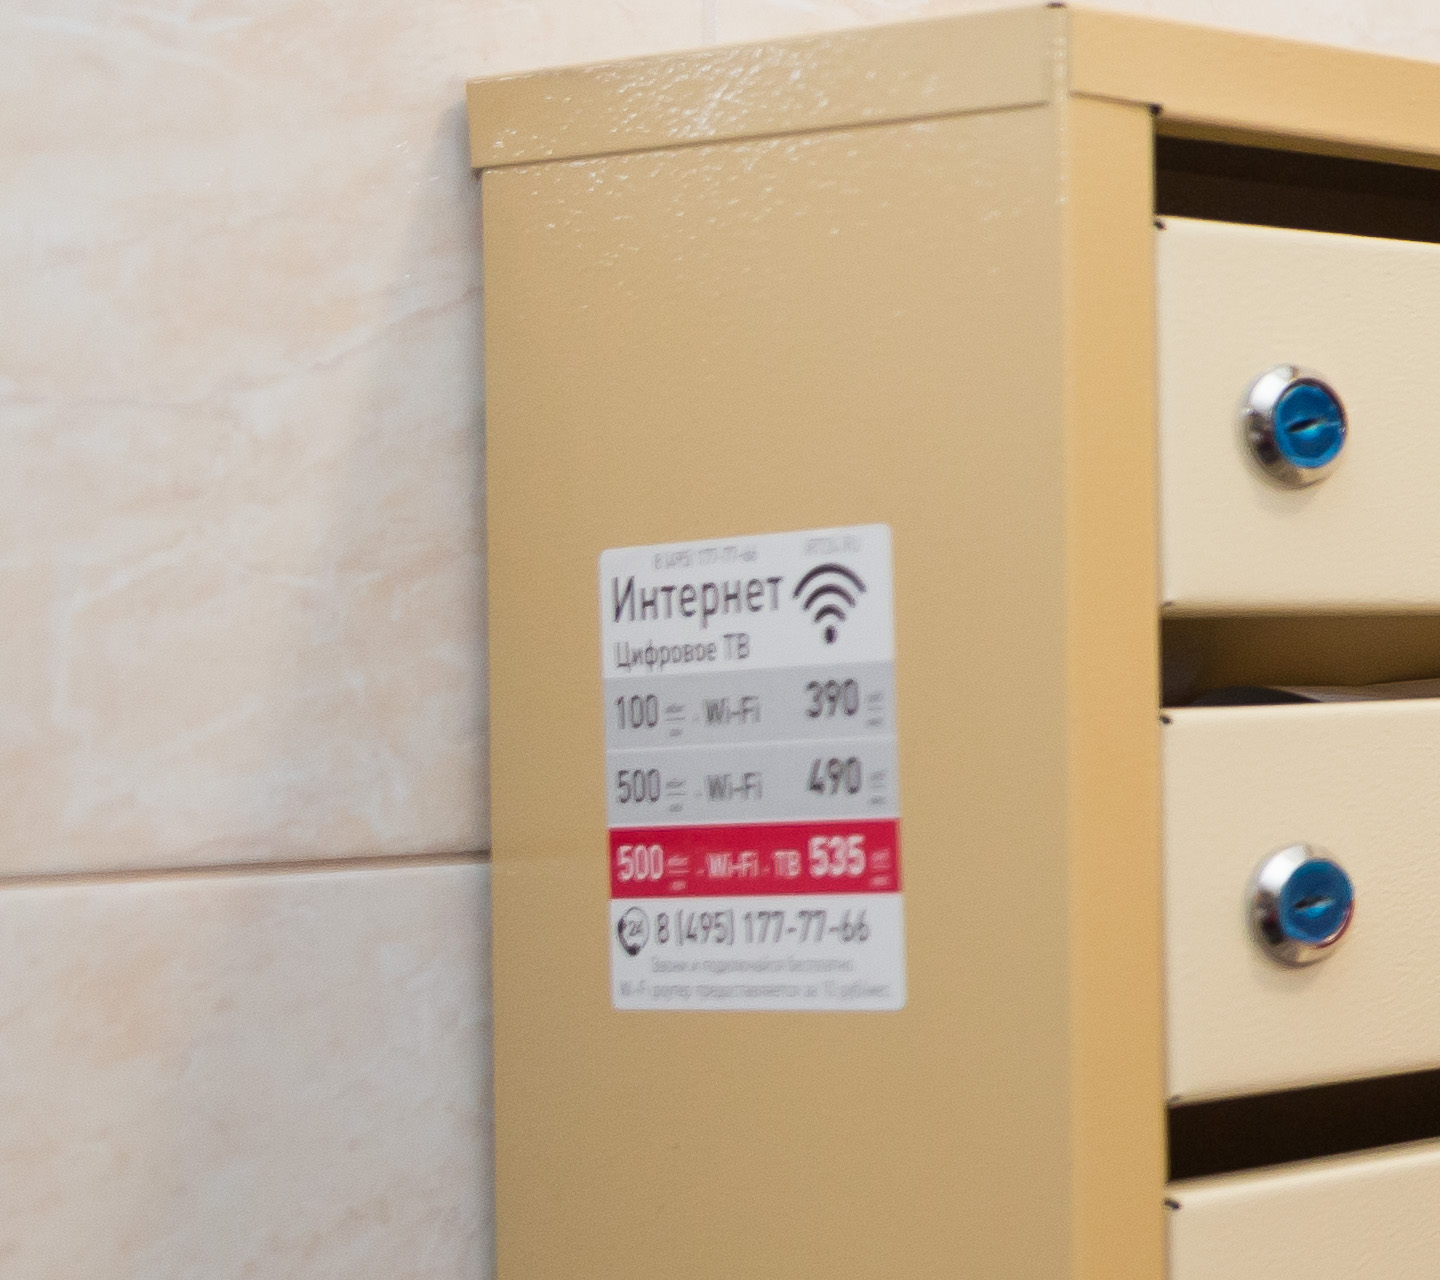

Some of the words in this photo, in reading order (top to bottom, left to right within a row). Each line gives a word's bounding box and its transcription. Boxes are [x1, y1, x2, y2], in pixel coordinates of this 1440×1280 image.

[612, 575, 783, 629] Интернет
[614, 639, 718, 673] Цифровое
[723, 631, 751, 660] ТВ
[616, 693, 659, 730] 100
[704, 695, 761, 725] Wi-Fi
[805, 678, 860, 719] 390
[616, 768, 662, 804] 500
[706, 772, 763, 802] Wi-Fi
[808, 756, 862, 796] 490
[616, 844, 664, 883] 500
[705, 851, 760, 879] Wi-Fi
[807, 834, 867, 879] 535
[657, 911, 670, 944] 8
[676, 908, 735, 947] (495)
[743, 908, 872, 945] 177-77-66
